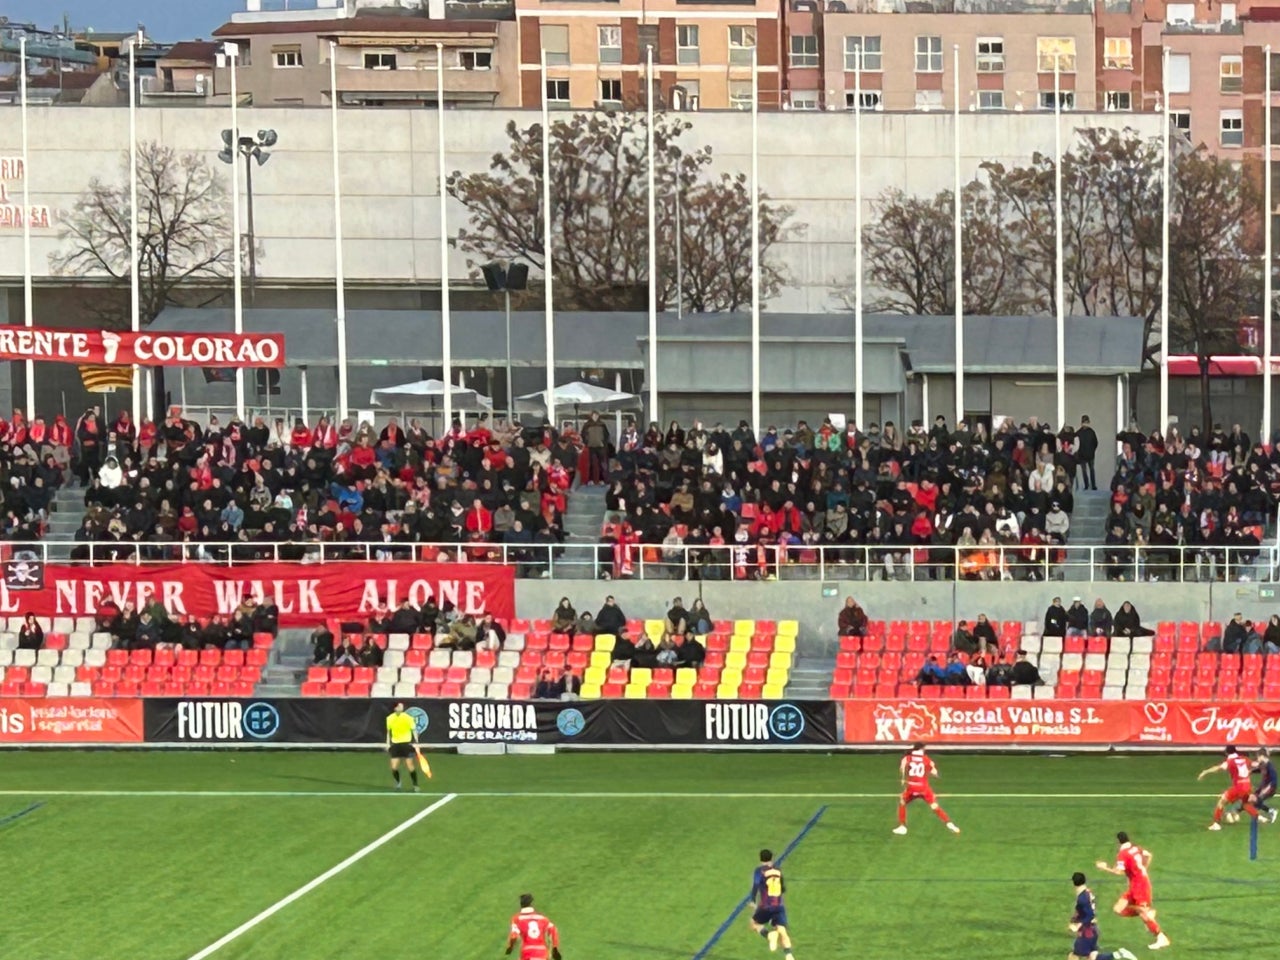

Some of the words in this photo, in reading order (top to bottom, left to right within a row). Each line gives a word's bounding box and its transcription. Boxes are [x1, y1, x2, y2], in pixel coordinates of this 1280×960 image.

[134, 336, 279, 362] COLORAO
[213, 579, 323, 614] WALK
[358, 579, 485, 614] ALONE
[449, 703, 537, 729] SEGUNDA
[940, 707, 1002, 723] Kordal
[1191, 707, 1257, 742] Juga
[875, 718, 915, 741] KV
[909, 762, 925, 778] 20
[528, 921, 540, 939] 8
